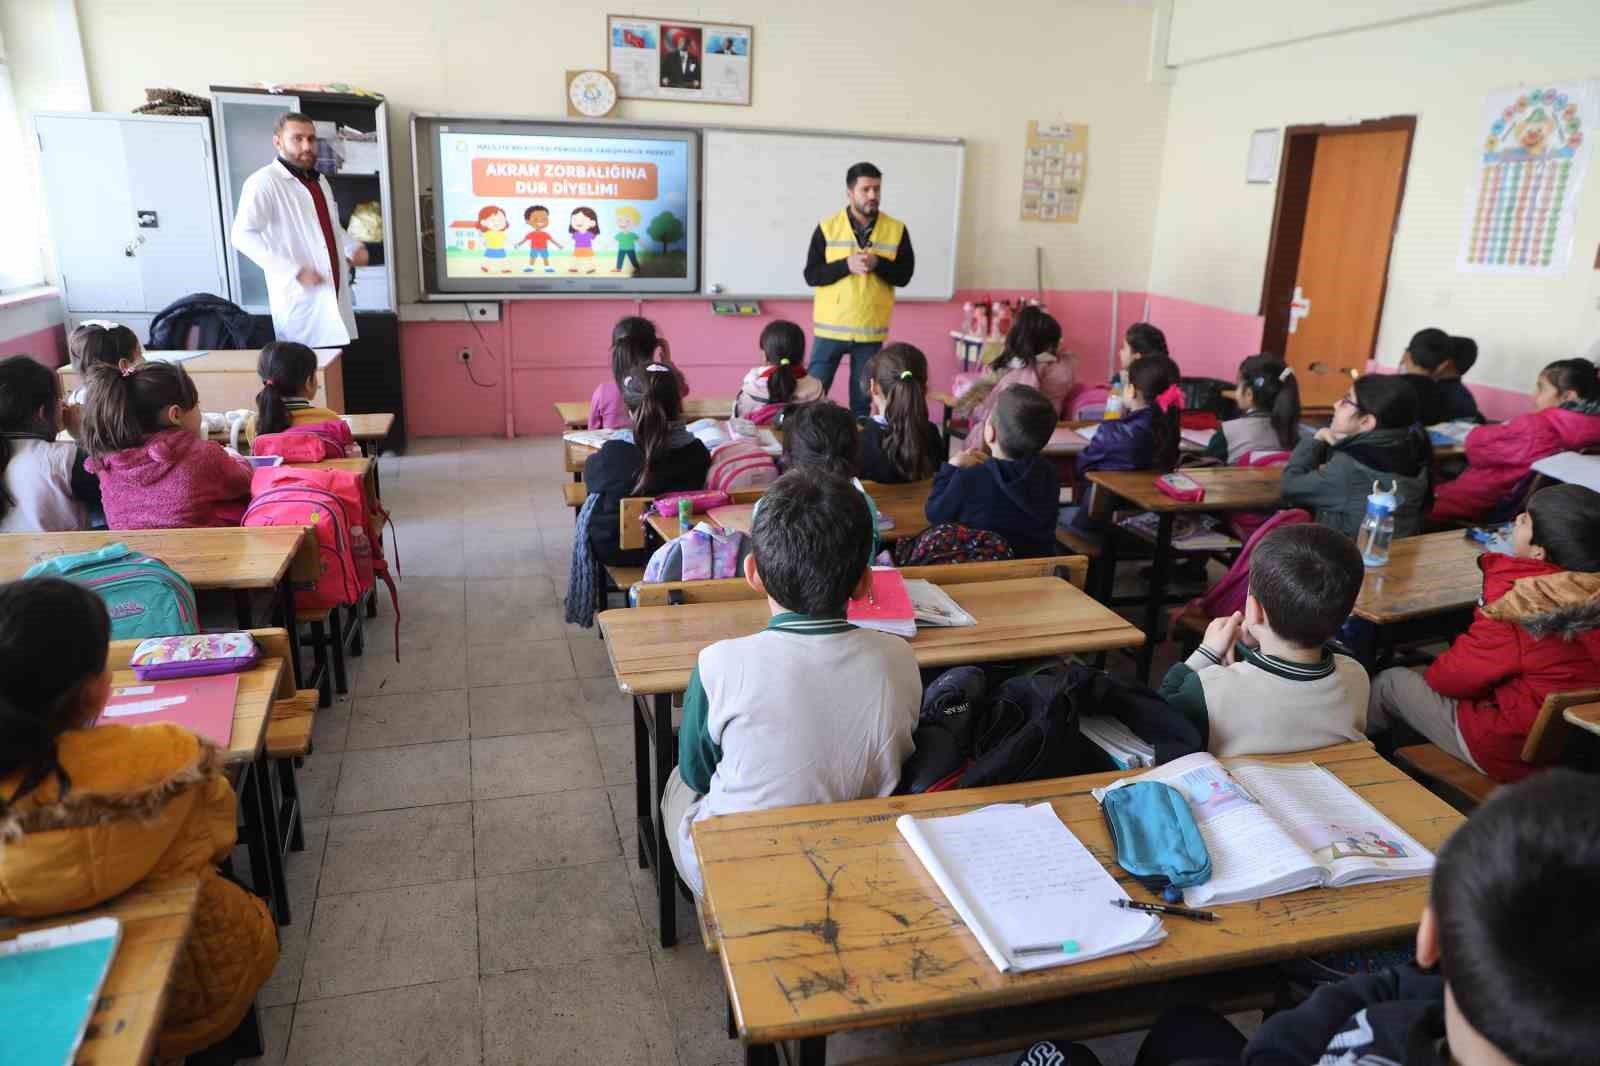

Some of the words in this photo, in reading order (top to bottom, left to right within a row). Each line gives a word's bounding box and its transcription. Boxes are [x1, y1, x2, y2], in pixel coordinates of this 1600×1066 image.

[486, 163, 540, 177] AKRAN
[544, 163, 647, 180] ZORBALIĞINA
[515, 181, 547, 193] DUR
[552, 179, 618, 195] DİYELİM!
